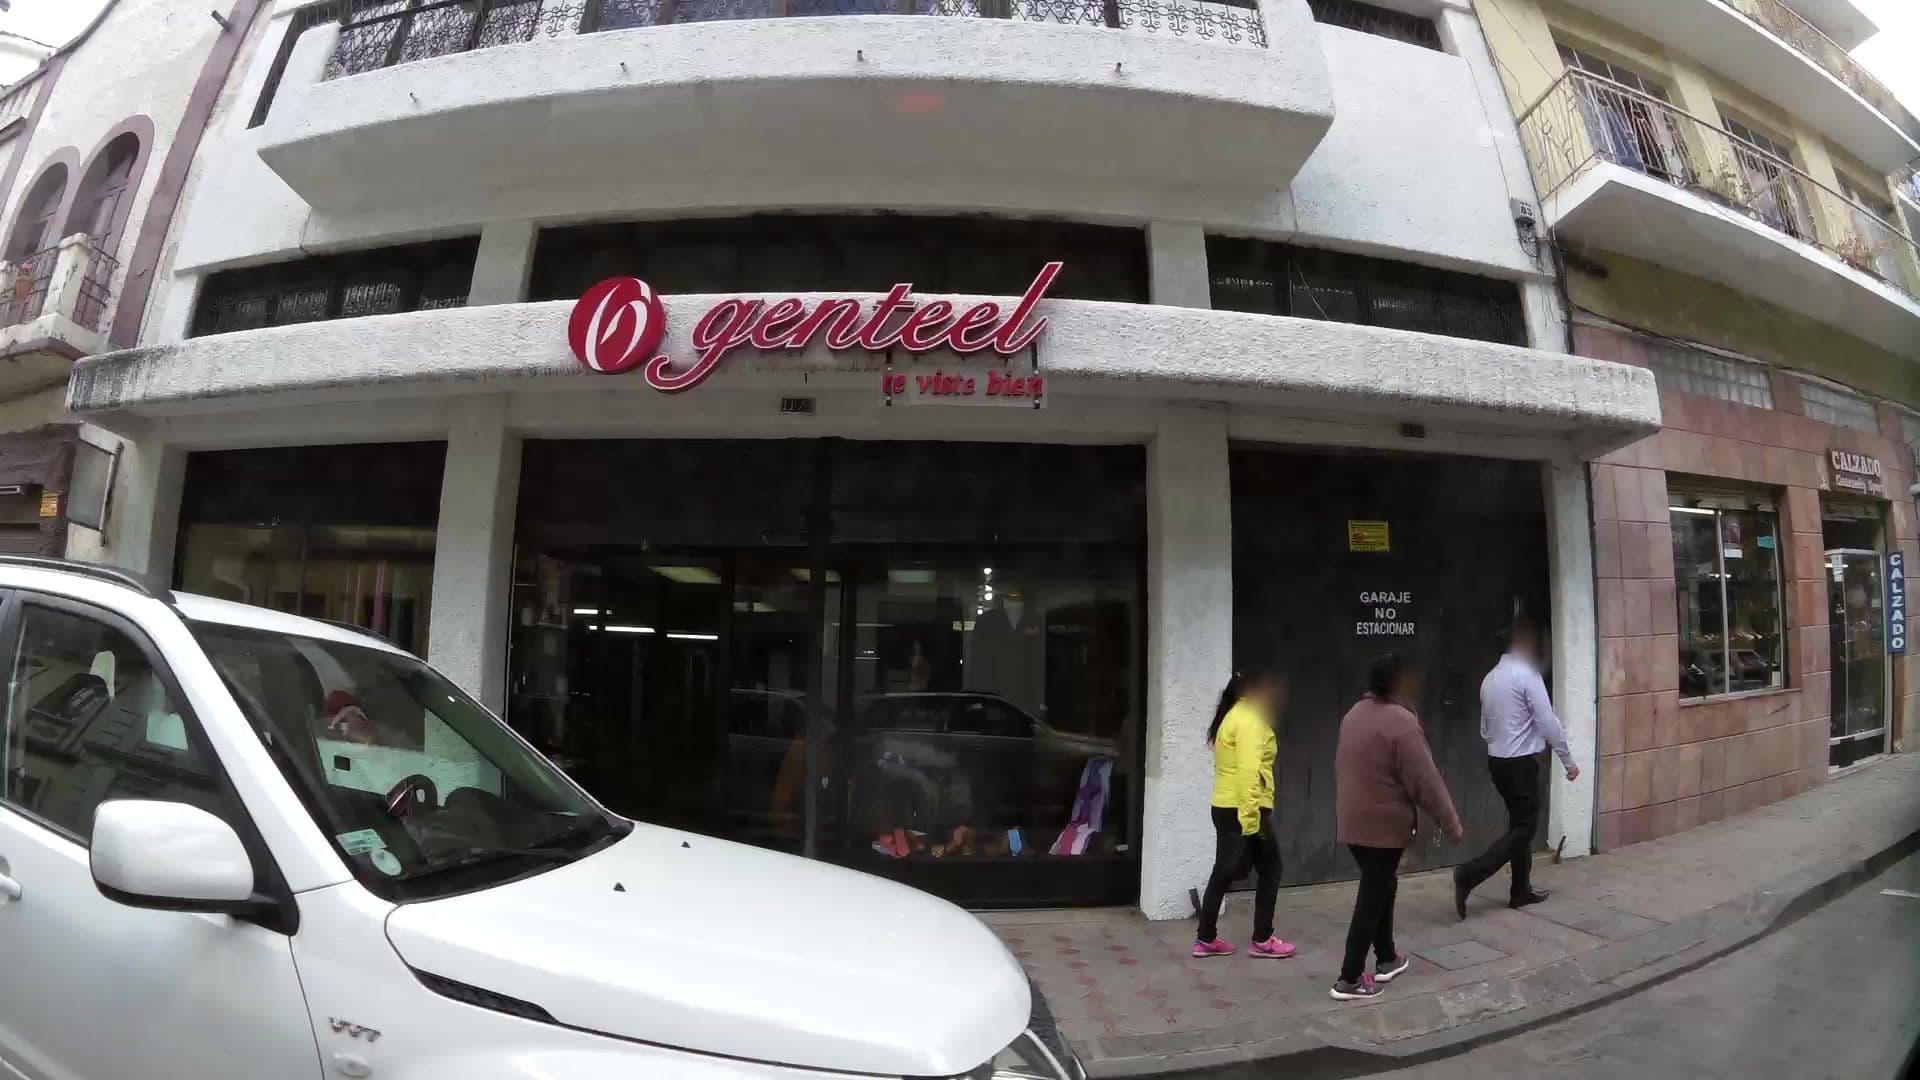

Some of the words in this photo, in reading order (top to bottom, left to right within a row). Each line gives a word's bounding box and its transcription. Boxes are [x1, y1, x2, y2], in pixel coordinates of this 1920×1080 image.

[644, 261, 1064, 392] genteel
[882, 374, 906, 395] te
[916, 369, 976, 396] viste
[986, 368, 1044, 397] bien
[1831, 450, 1881, 477] CALZADO
[1360, 591, 1411, 603] GARAJE
[1890, 554, 1905, 649] CALZADO
[1375, 607, 1396, 620] NO
[1356, 622, 1415, 635] ESTACIONAR
